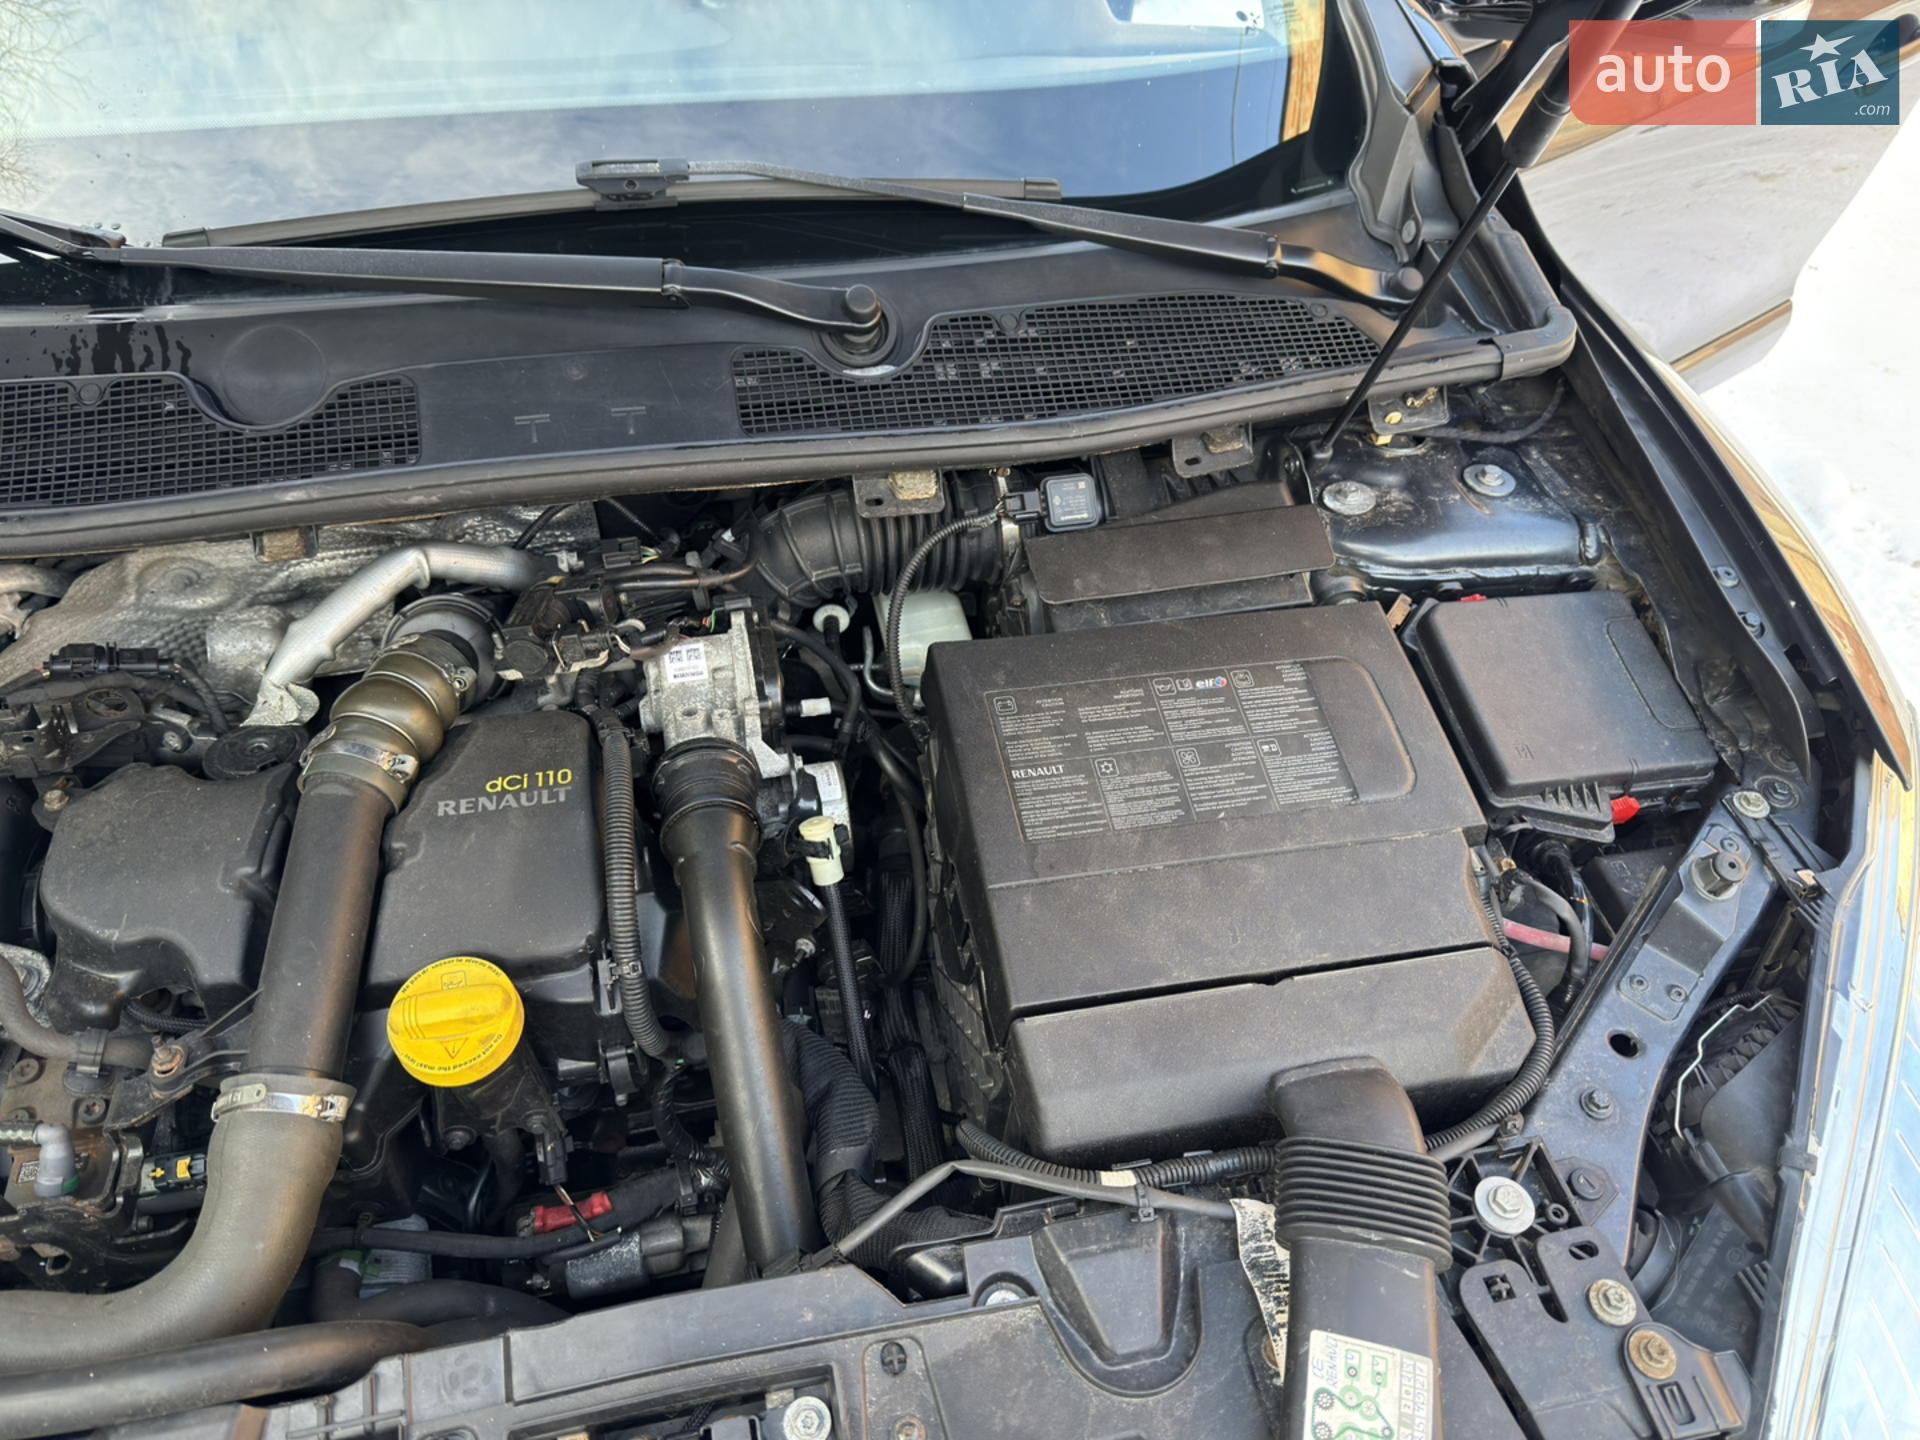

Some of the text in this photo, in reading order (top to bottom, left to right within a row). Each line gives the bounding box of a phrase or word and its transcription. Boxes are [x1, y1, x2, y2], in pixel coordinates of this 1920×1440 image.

[485, 768, 573, 793] dCi 110
[1011, 764, 1064, 779] RENAULT
[437, 786, 572, 817] RENAULT
